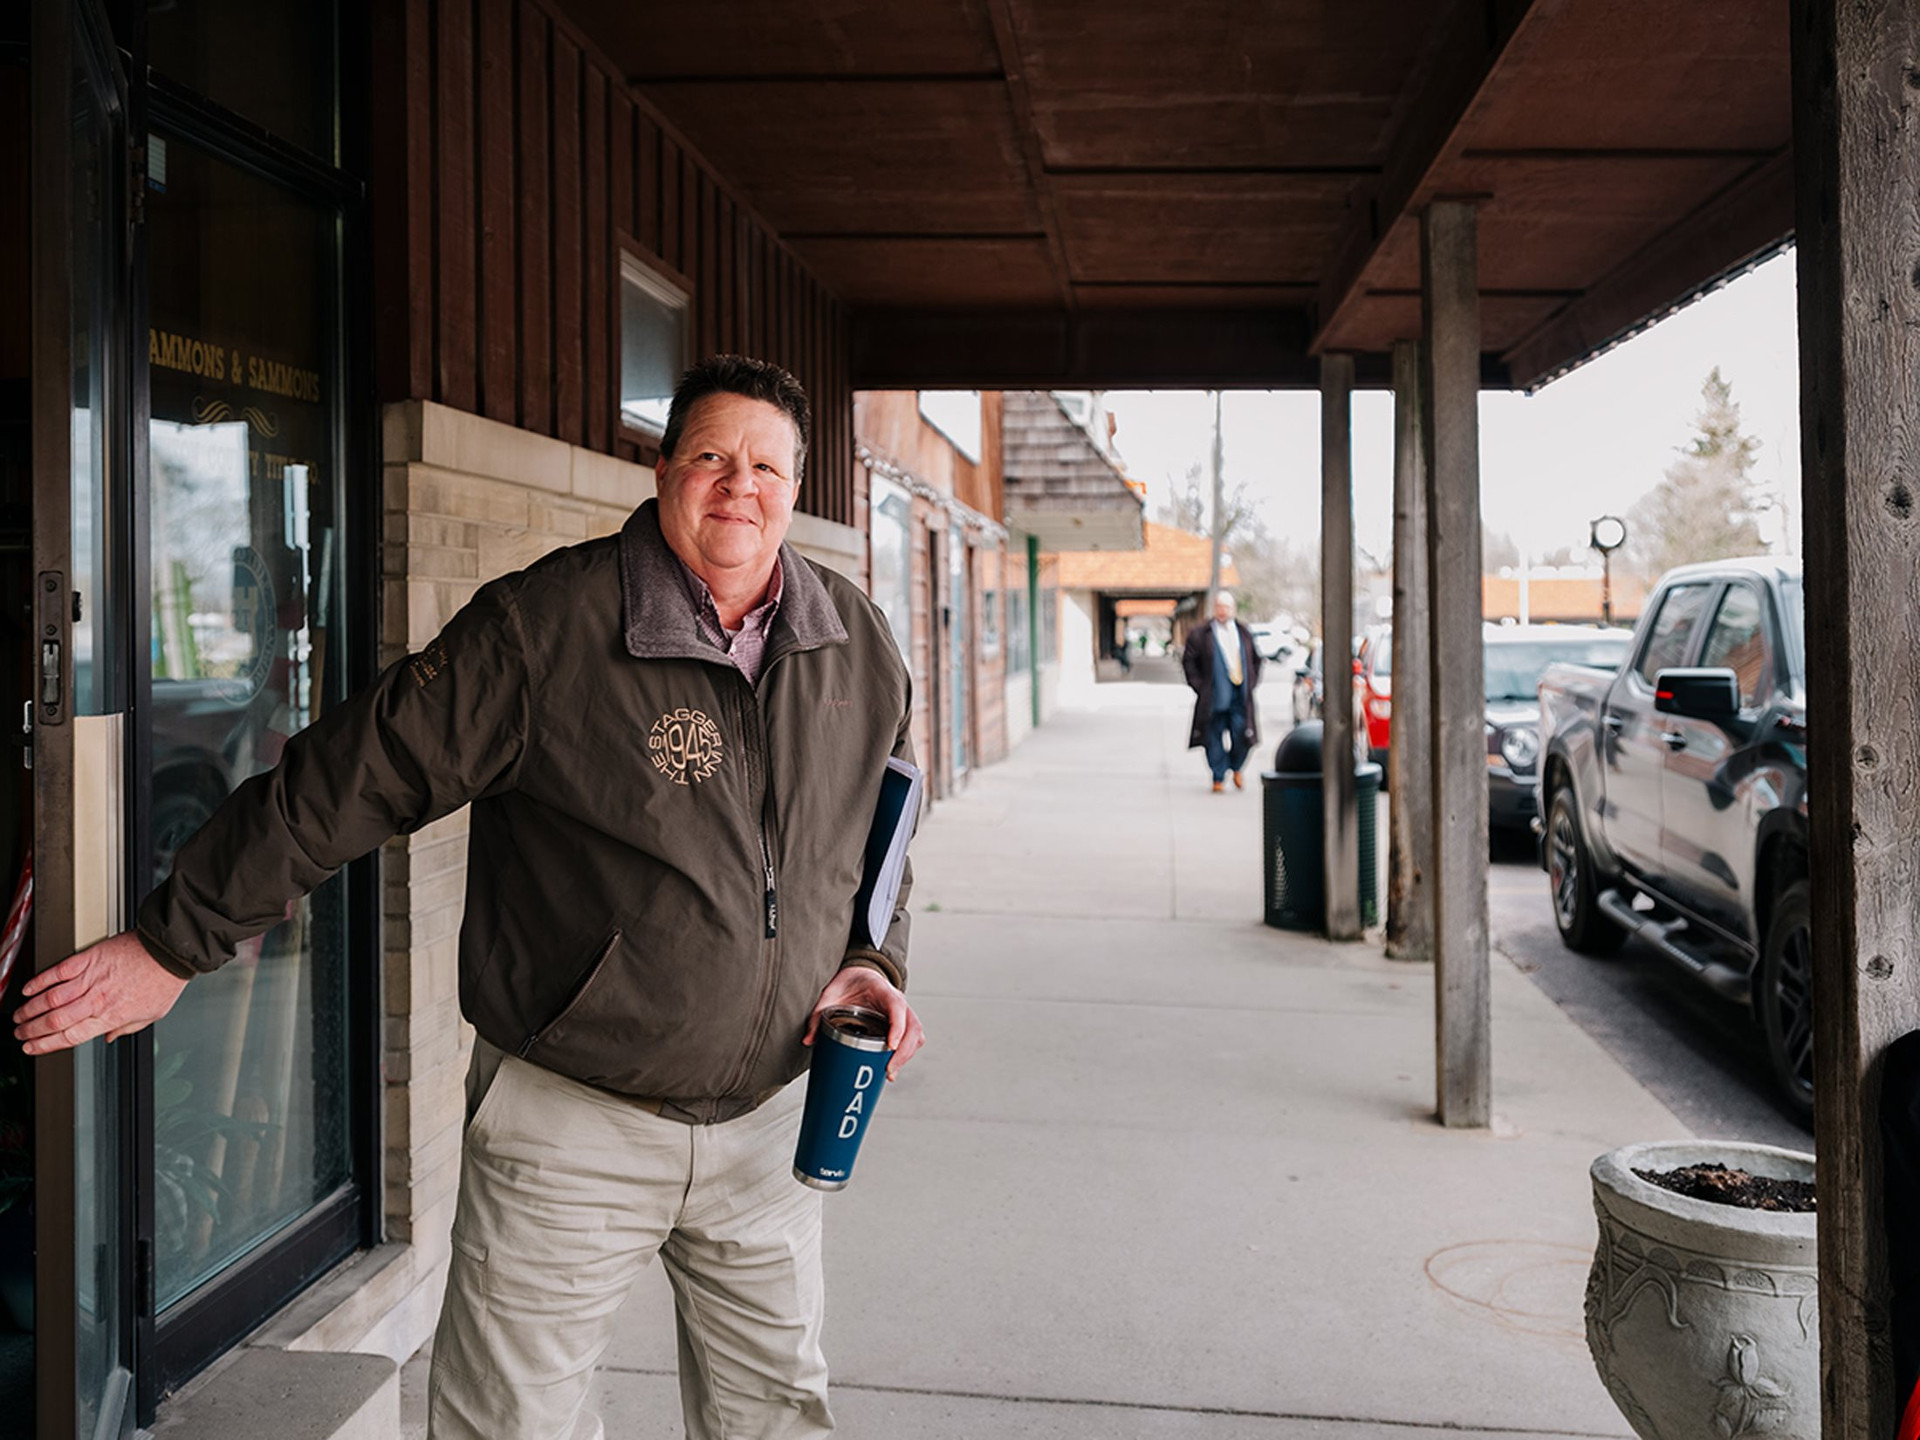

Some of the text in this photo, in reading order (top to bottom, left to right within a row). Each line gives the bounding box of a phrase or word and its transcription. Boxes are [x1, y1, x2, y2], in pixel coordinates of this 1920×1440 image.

[149, 328, 320, 402] AMMONS & SAMMONS
[649, 708, 722, 749] STAGGER
[662, 722, 712, 770] 1945
[651, 751, 690, 785] THE
[837, 1064, 874, 1139] DAD
